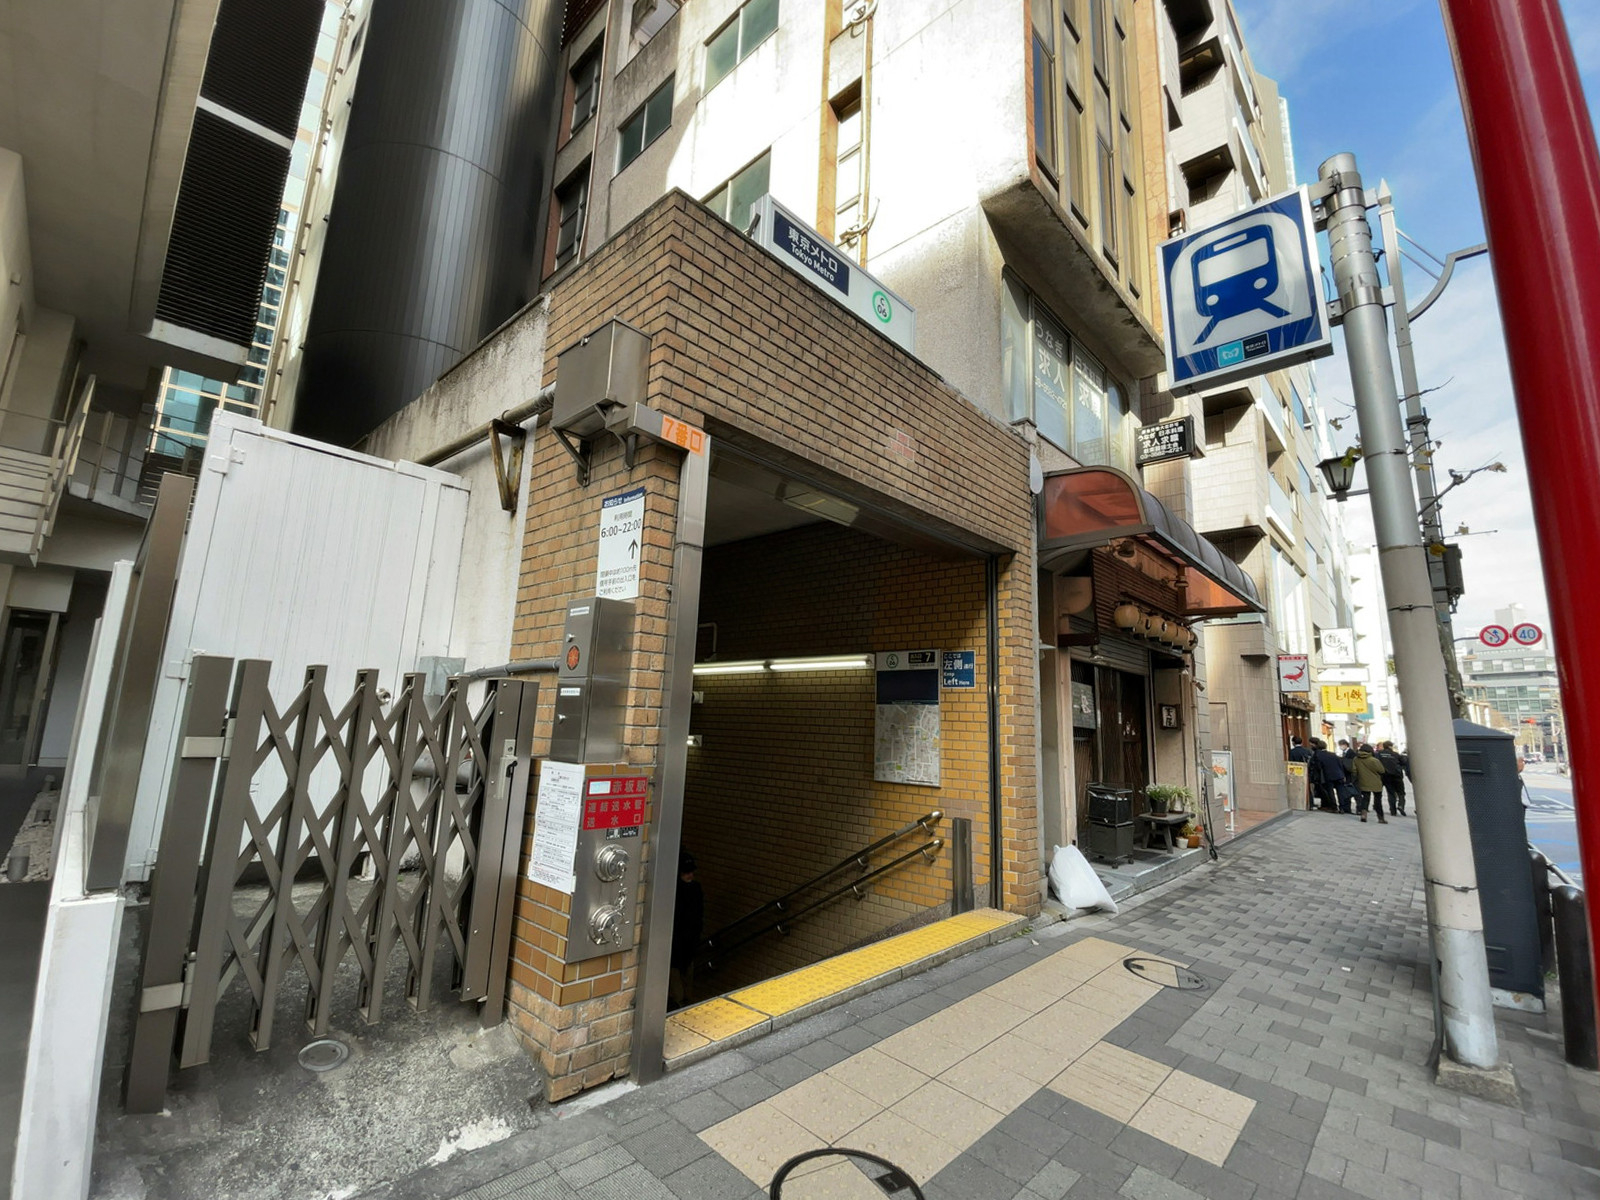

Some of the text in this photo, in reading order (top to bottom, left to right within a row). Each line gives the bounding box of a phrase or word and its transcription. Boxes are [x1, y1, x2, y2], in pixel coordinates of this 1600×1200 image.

[788, 226, 838, 273] 東京メトロ
[791, 245, 835, 282] Tokyo Metro
[879, 297, 885, 306] C
[877, 304, 887, 318] 06
[1038, 348, 1065, 392] 求人
[664, 417, 702, 453] 7番口
[1518, 628, 1536, 640] 40
[925, 652, 932, 662] 7
[943, 677, 958, 686] Left
[612, 780, 646, 793] 赤坂駅
[588, 799, 642, 813] 連結送水管
[587, 813, 641, 828] 送水口
